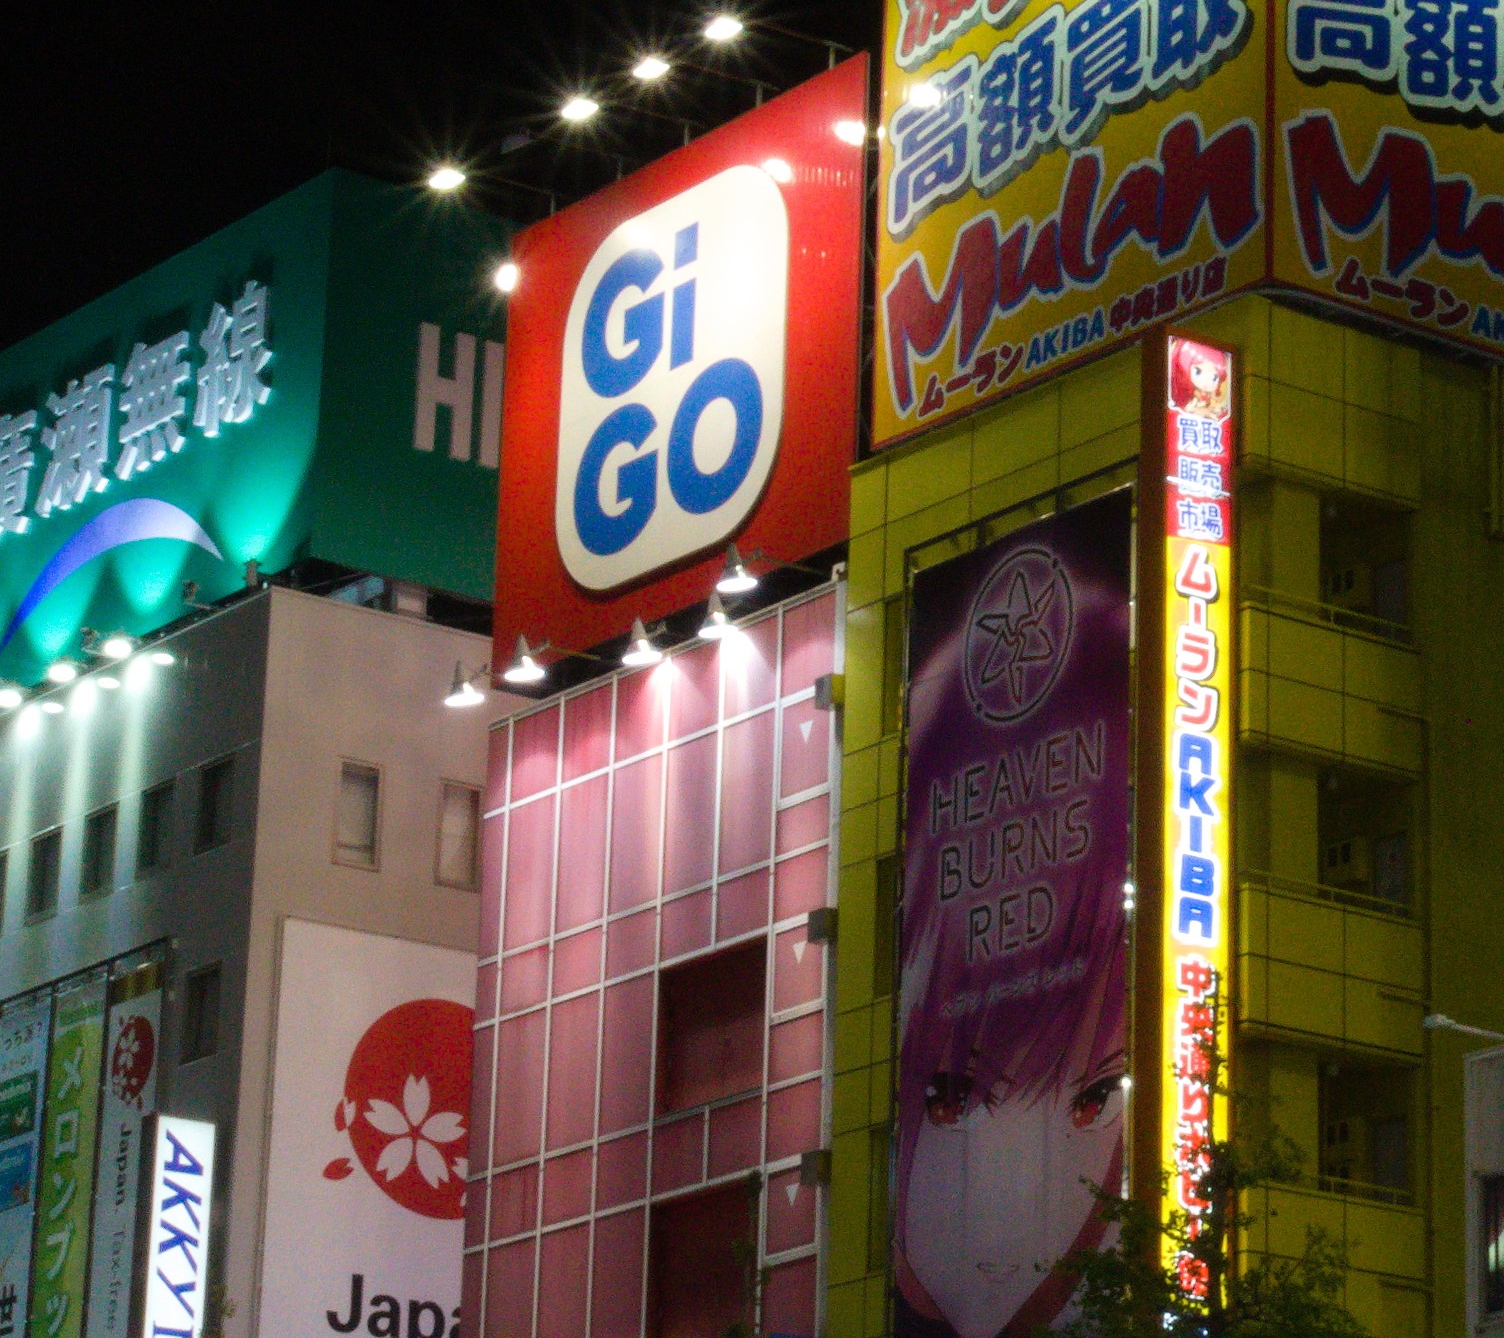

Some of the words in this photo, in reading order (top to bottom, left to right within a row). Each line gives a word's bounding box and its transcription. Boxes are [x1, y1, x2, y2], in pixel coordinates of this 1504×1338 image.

[887, 116, 1262, 413] Mulan
[1337, 258, 1469, 325] ムーラン
[919, 345, 1023, 414] ムーラン
[1025, 307, 1106, 370] AKIBA
[574, 356, 763, 556] GO
[1177, 416, 1223, 457] 買取
[1178, 458, 1221, 498] 販売
[1177, 499, 1223, 538] 市場
[1177, 547, 1219, 732] ムーラン
[930, 721, 1102, 836] HEAVEN
[940, 798, 1093, 902] BURNS
[1174, 732, 1220, 943] AKIBA
[968, 883, 1056, 963] RED
[149, 1131, 207, 1318] AKKY
[104, 1229, 122, 1338] Tax-free
